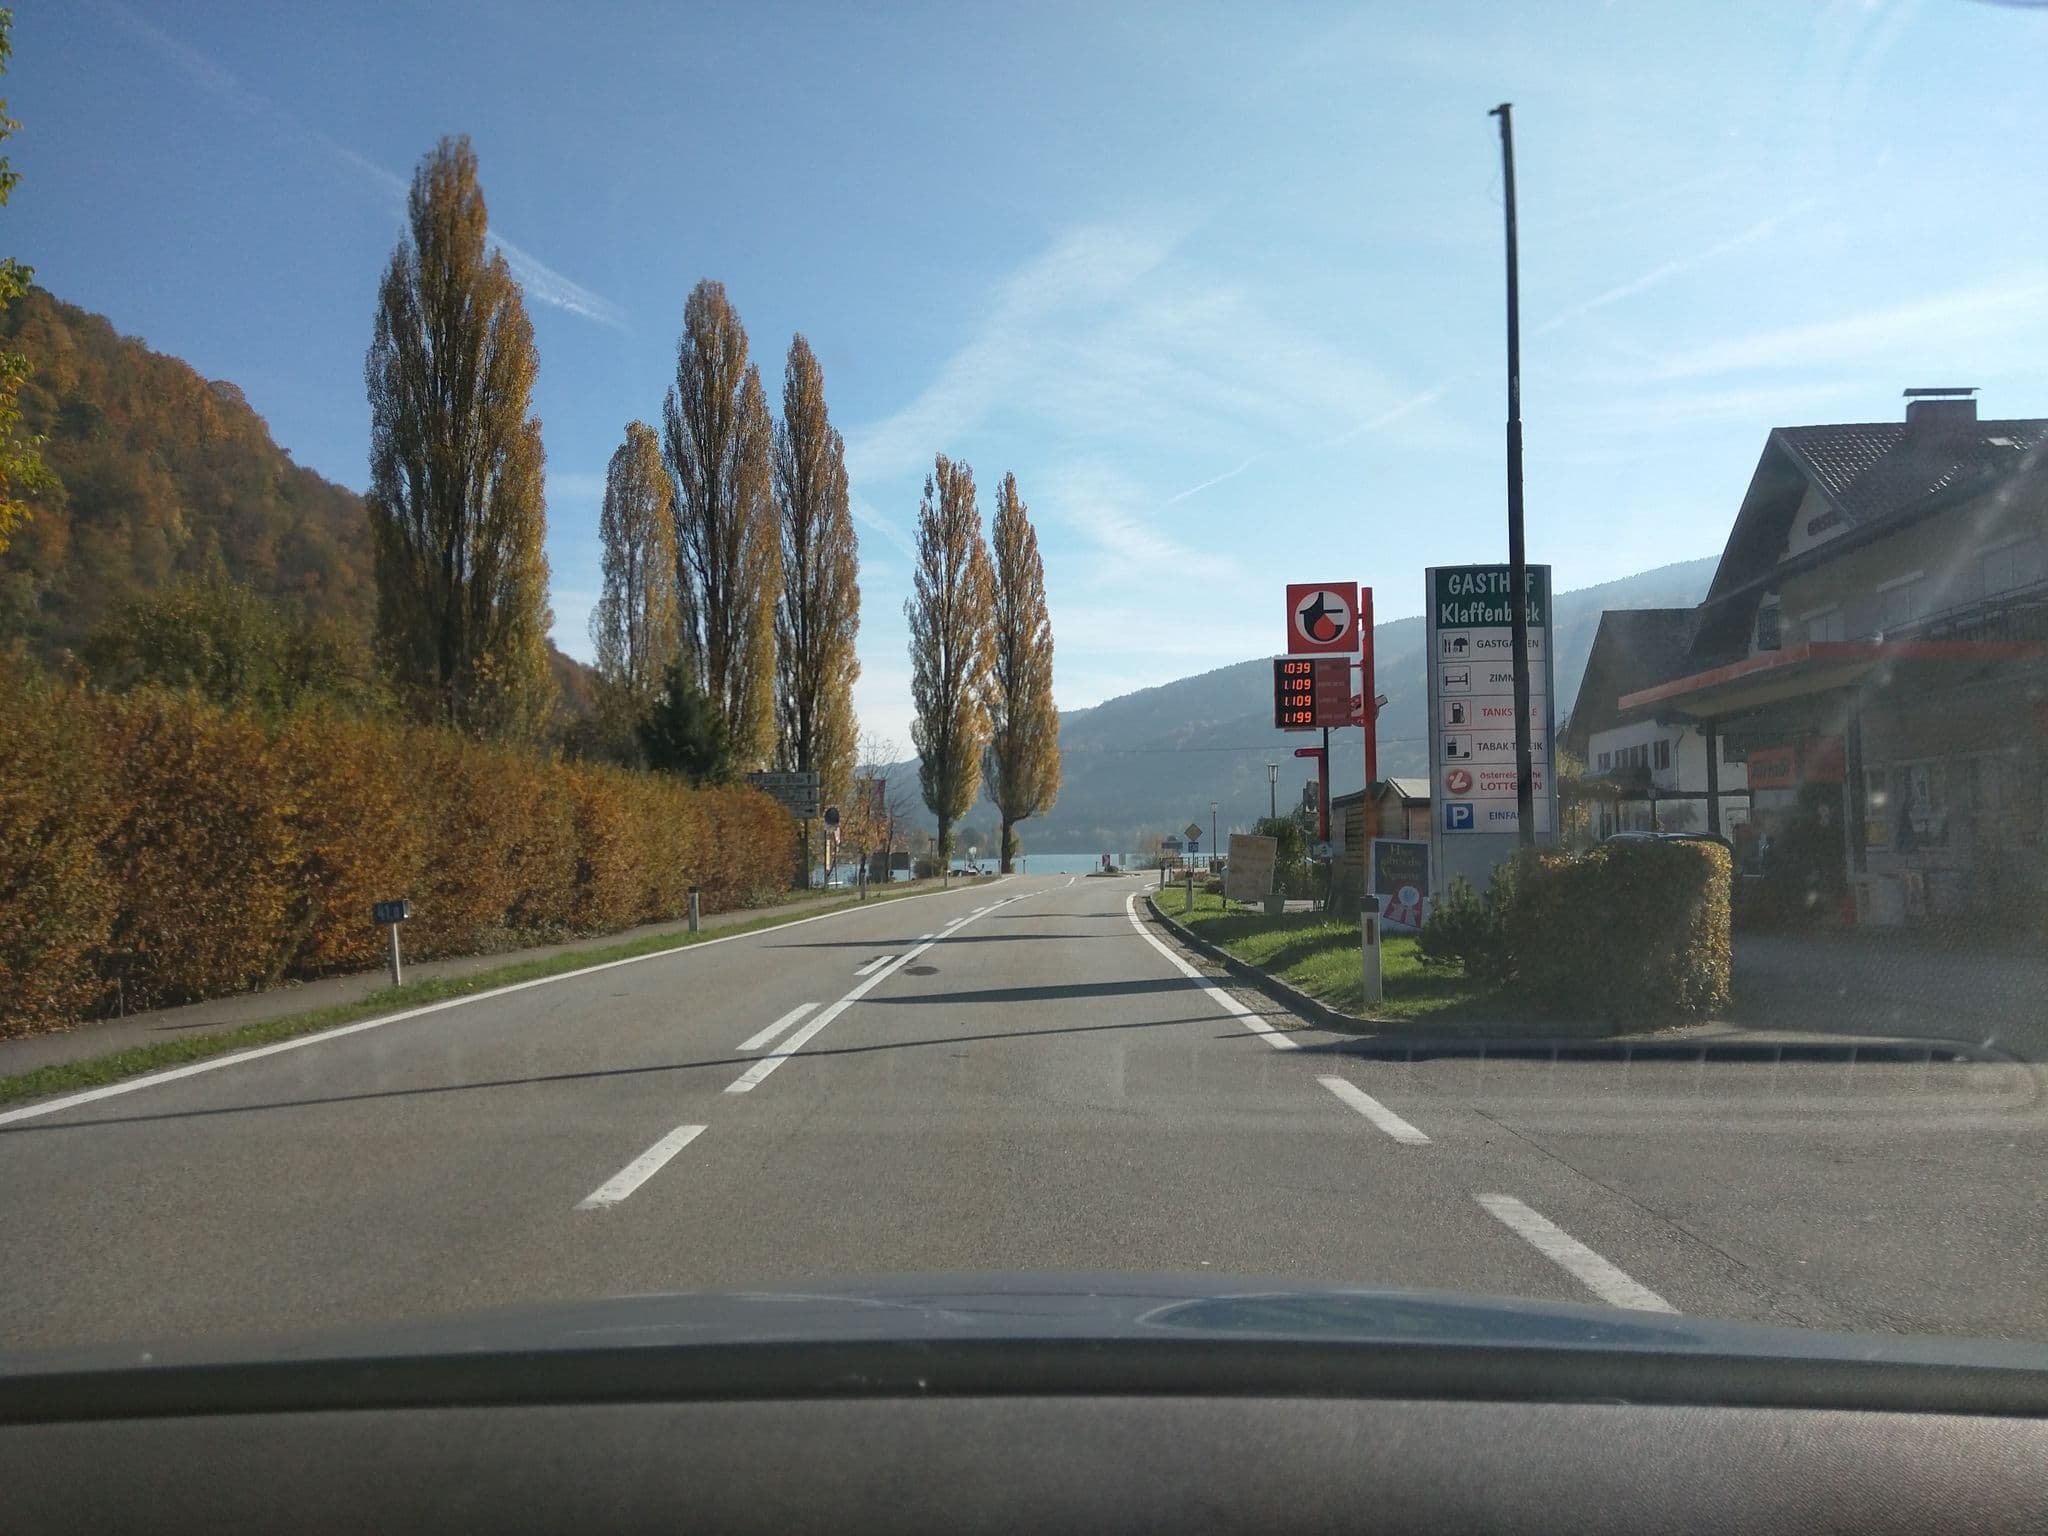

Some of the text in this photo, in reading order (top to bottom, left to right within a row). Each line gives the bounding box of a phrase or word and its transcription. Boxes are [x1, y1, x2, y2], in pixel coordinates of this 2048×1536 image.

[1448, 572, 1535, 595] GASTHF
[1441, 600, 1540, 624] Klaffenbck
[1476, 639, 1539, 649] GASTGAEN
[1489, 673, 1515, 683] ZIMM
[1482, 708, 1537, 717] TANKSE
[1478, 742, 1543, 751] TABAK TIK
[1480, 771, 1541, 779] österreiche
[1481, 782, 1542, 791] LOTTEN
[1489, 811, 1520, 821] EINFA
